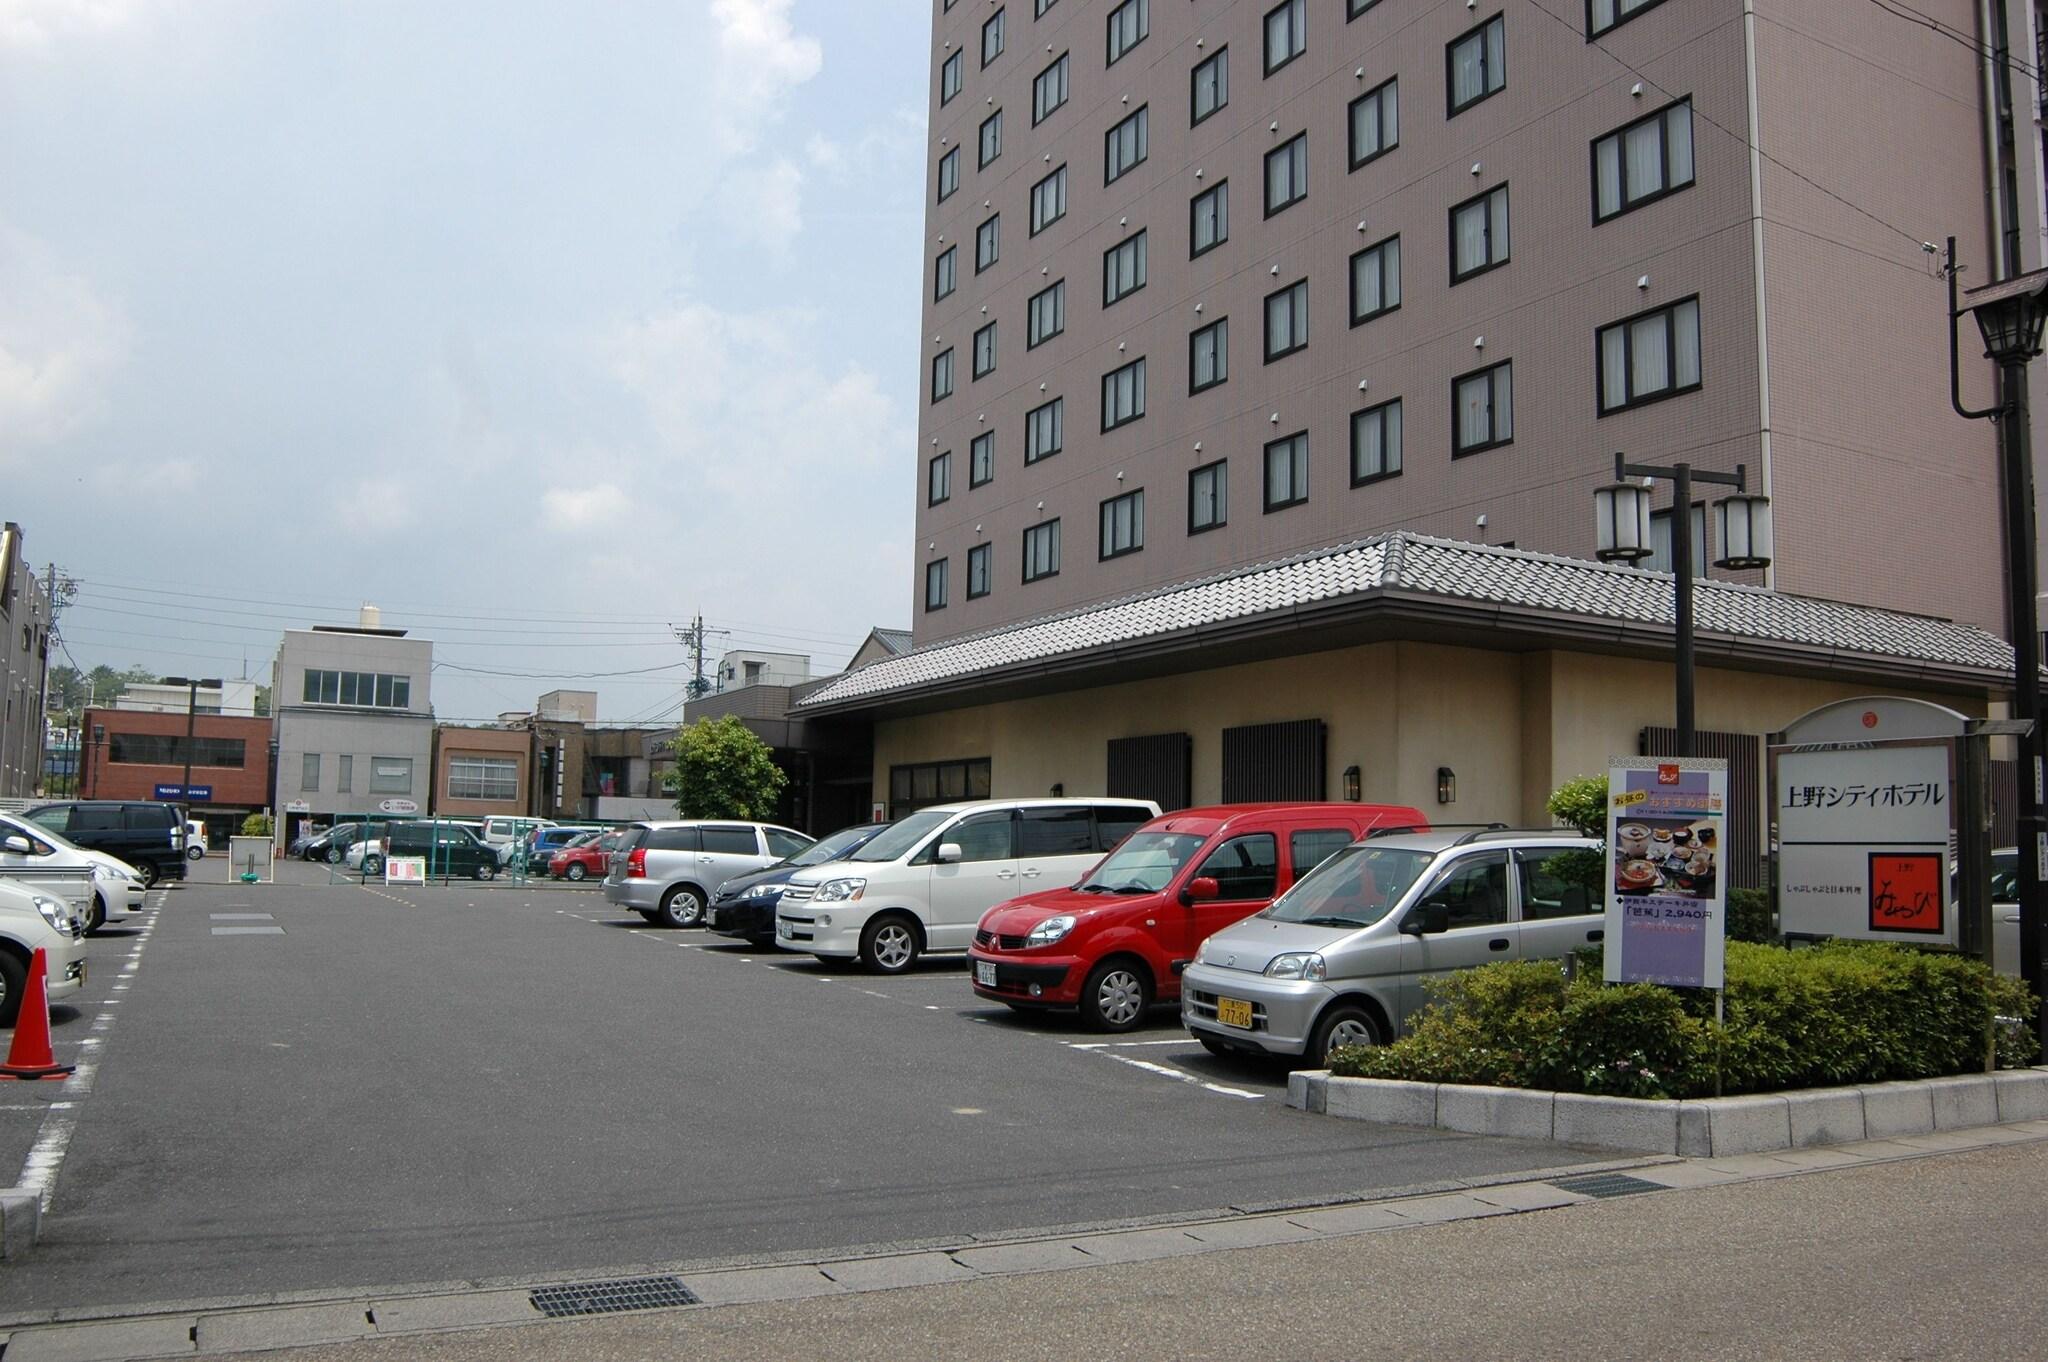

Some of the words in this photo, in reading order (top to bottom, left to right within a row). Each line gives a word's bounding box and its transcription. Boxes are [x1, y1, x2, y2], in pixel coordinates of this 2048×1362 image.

[1782, 783, 1944, 809] 上野シティホテル
[1786, 884, 1862, 895] しゃぶしゃぶと日本料理
